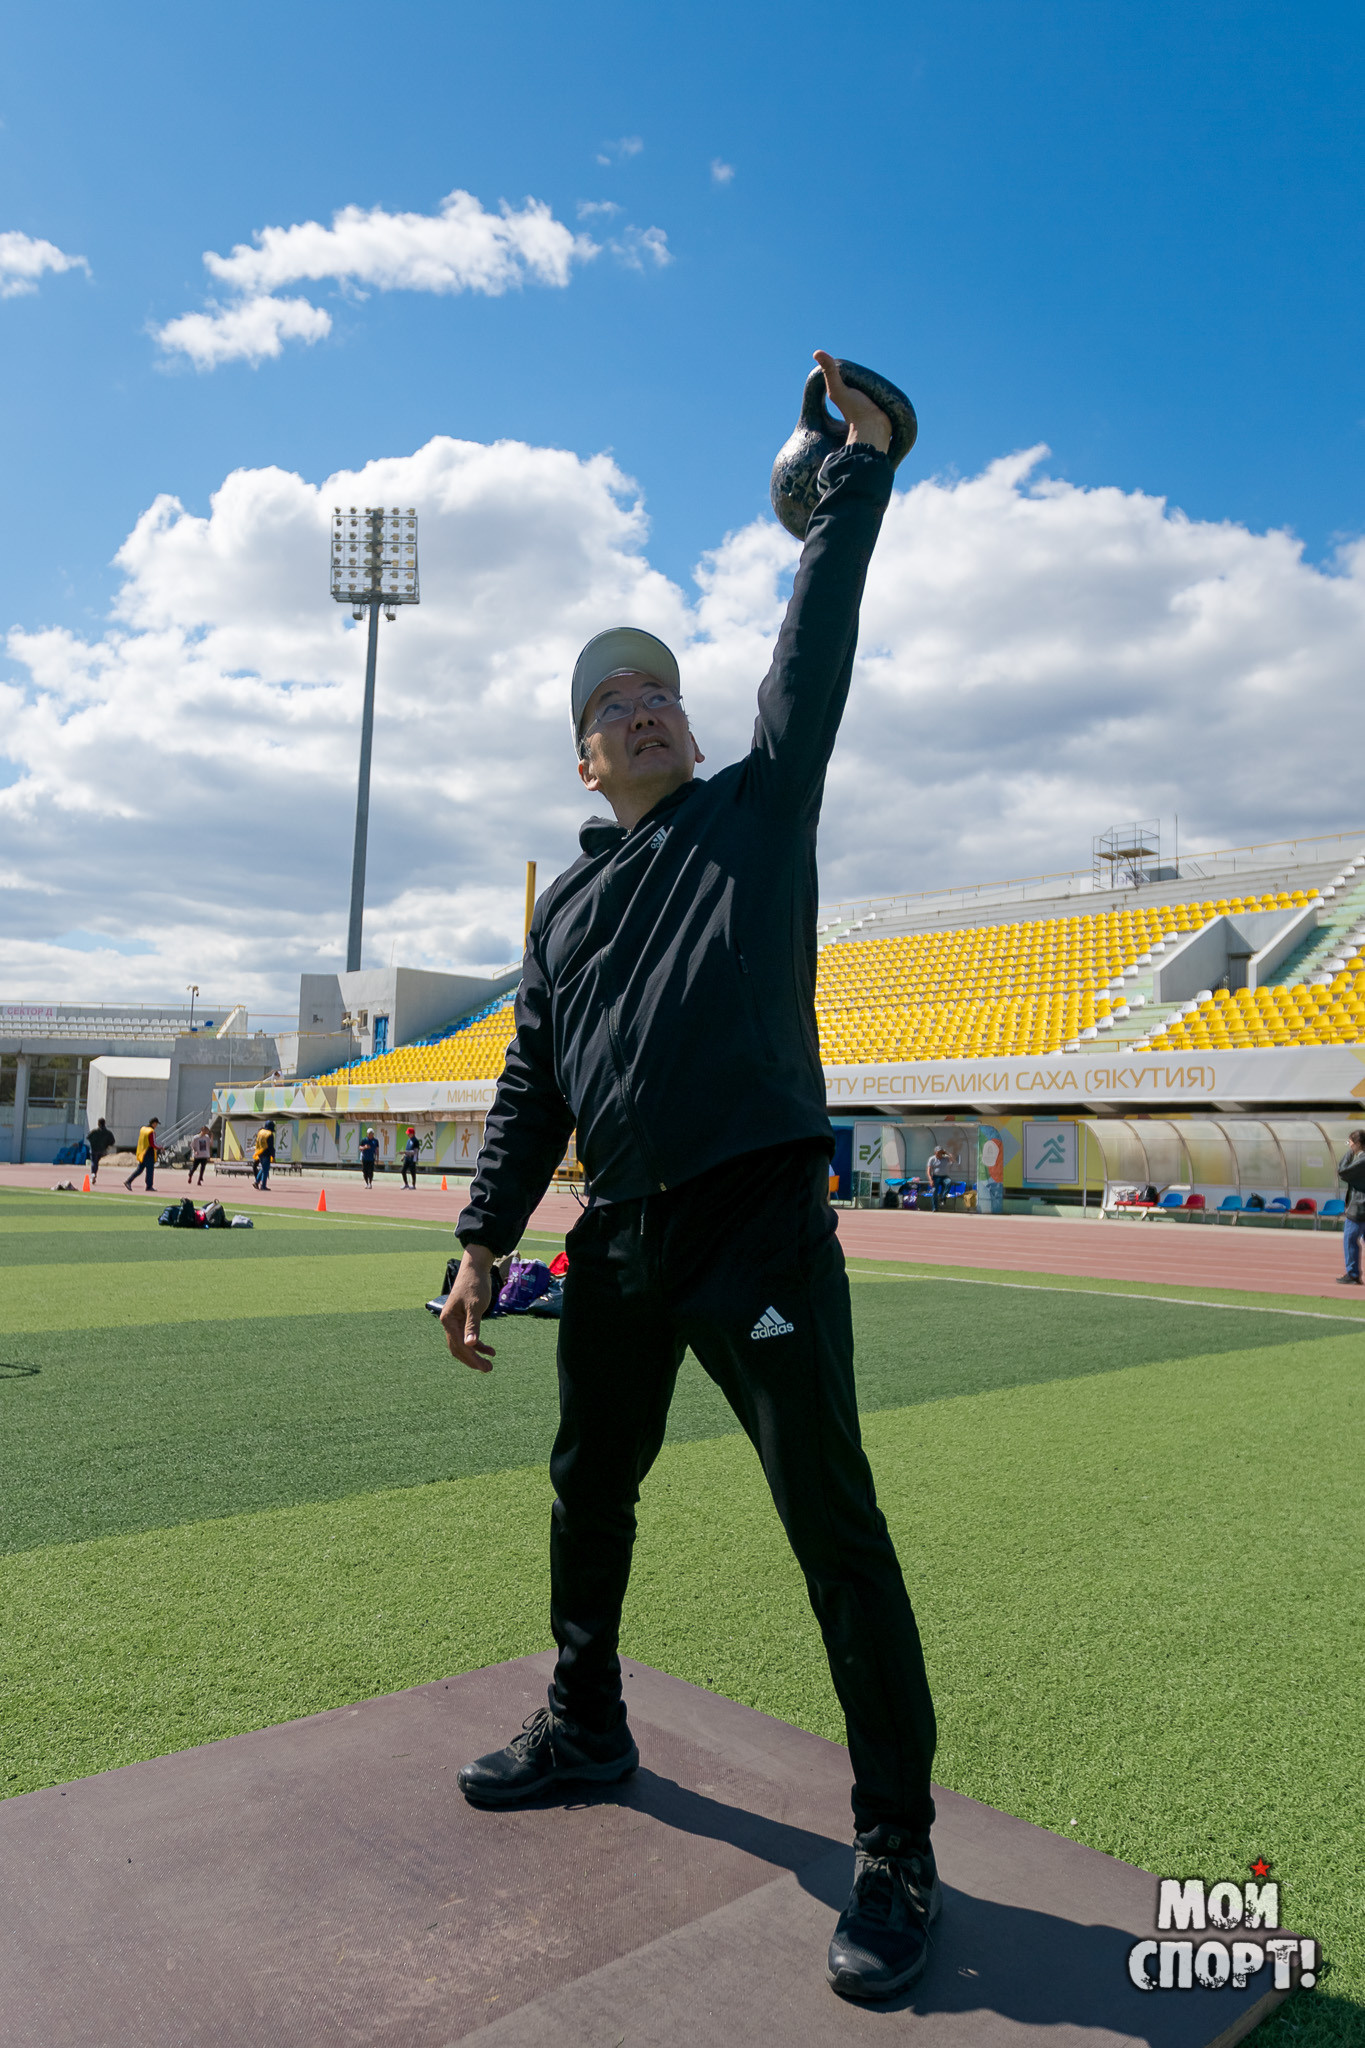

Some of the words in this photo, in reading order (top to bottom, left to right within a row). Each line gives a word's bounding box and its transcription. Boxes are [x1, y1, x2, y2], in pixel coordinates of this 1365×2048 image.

[7, 1006, 44, 1016] СЕКТОР
[45, 1007, 53, 1017] Д
[863, 1072, 1010, 1094] РЕСПУБЛИКИ
[1016, 1070, 1079, 1091] САХА
[1086, 1066, 1217, 1093] (ЯКУТИЯ)
[750, 1322, 795, 1340] adidas
